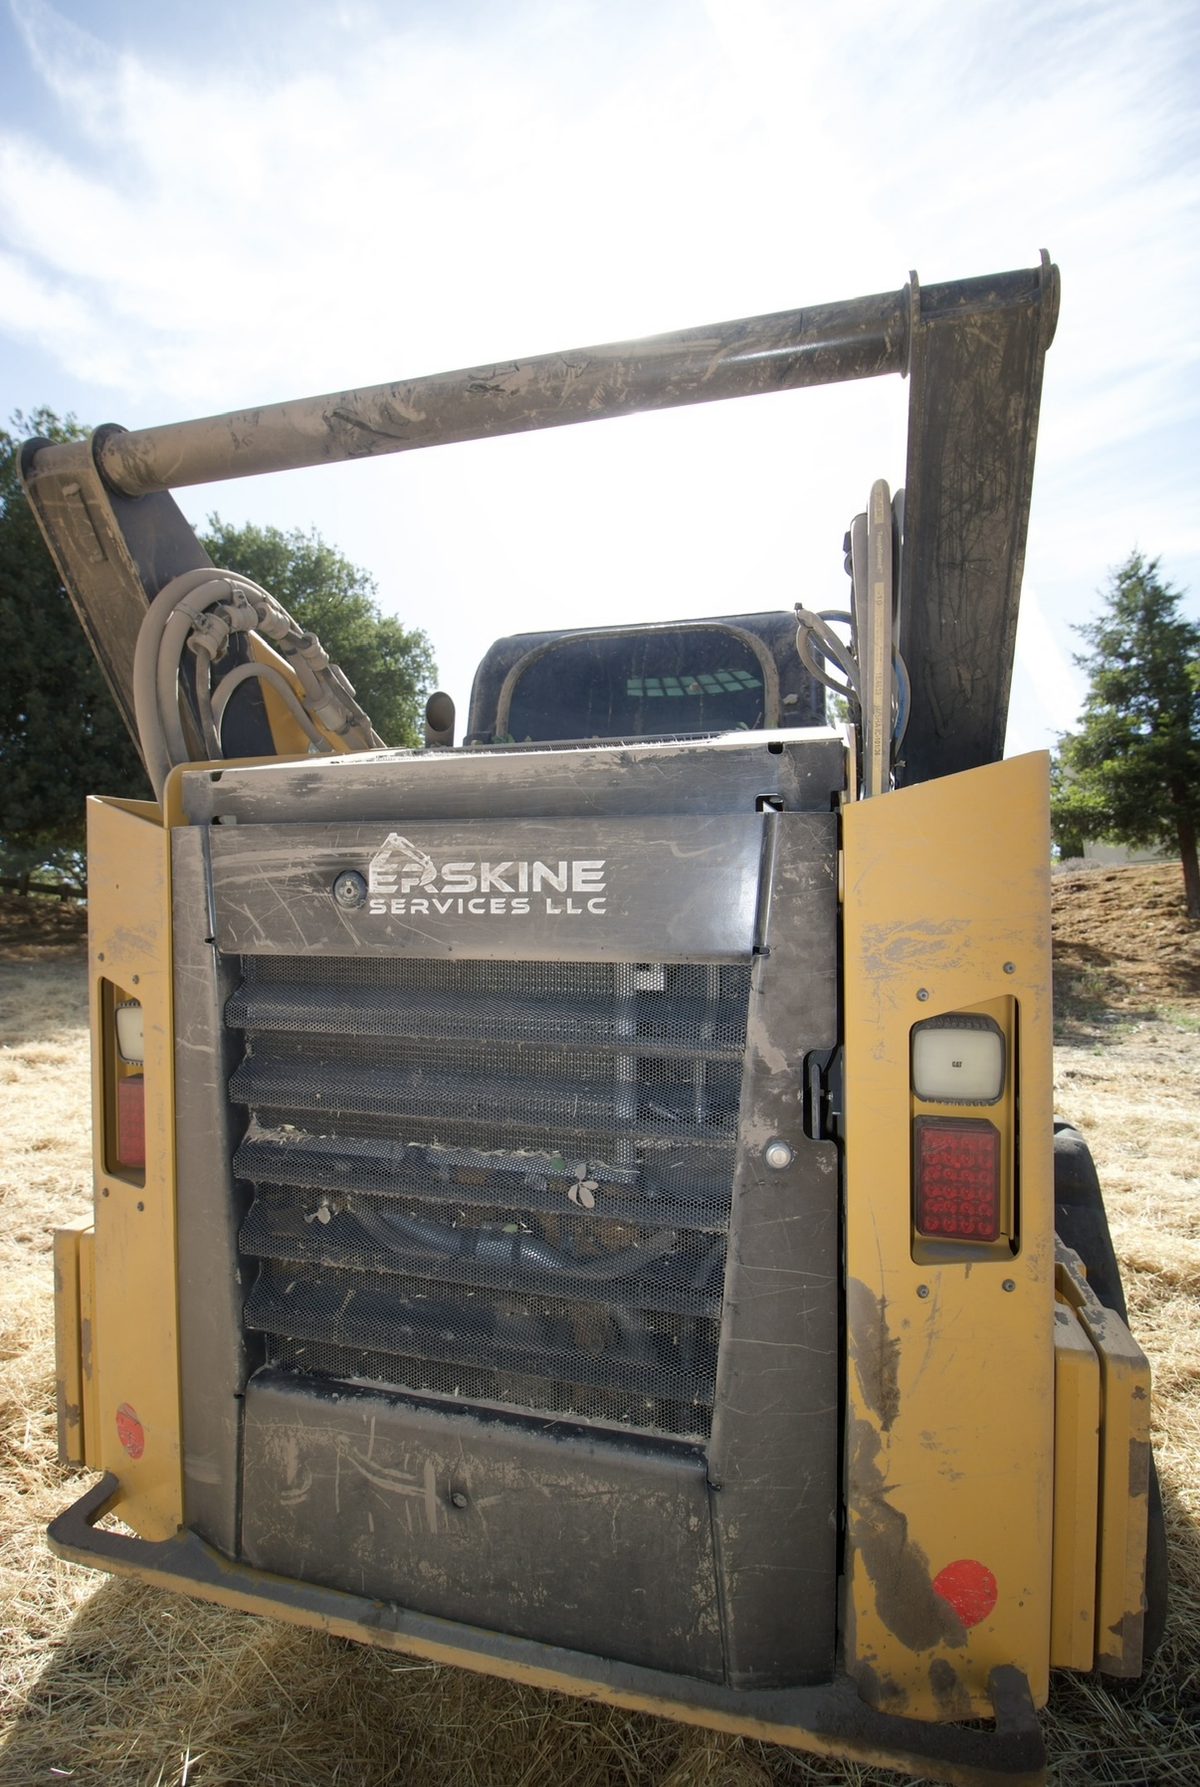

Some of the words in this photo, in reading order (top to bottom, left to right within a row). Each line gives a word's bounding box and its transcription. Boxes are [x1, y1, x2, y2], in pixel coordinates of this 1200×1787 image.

[368, 851, 607, 894] ERSKINE
[369, 898, 531, 915] SERVICES
[546, 897, 607, 914] LLC
